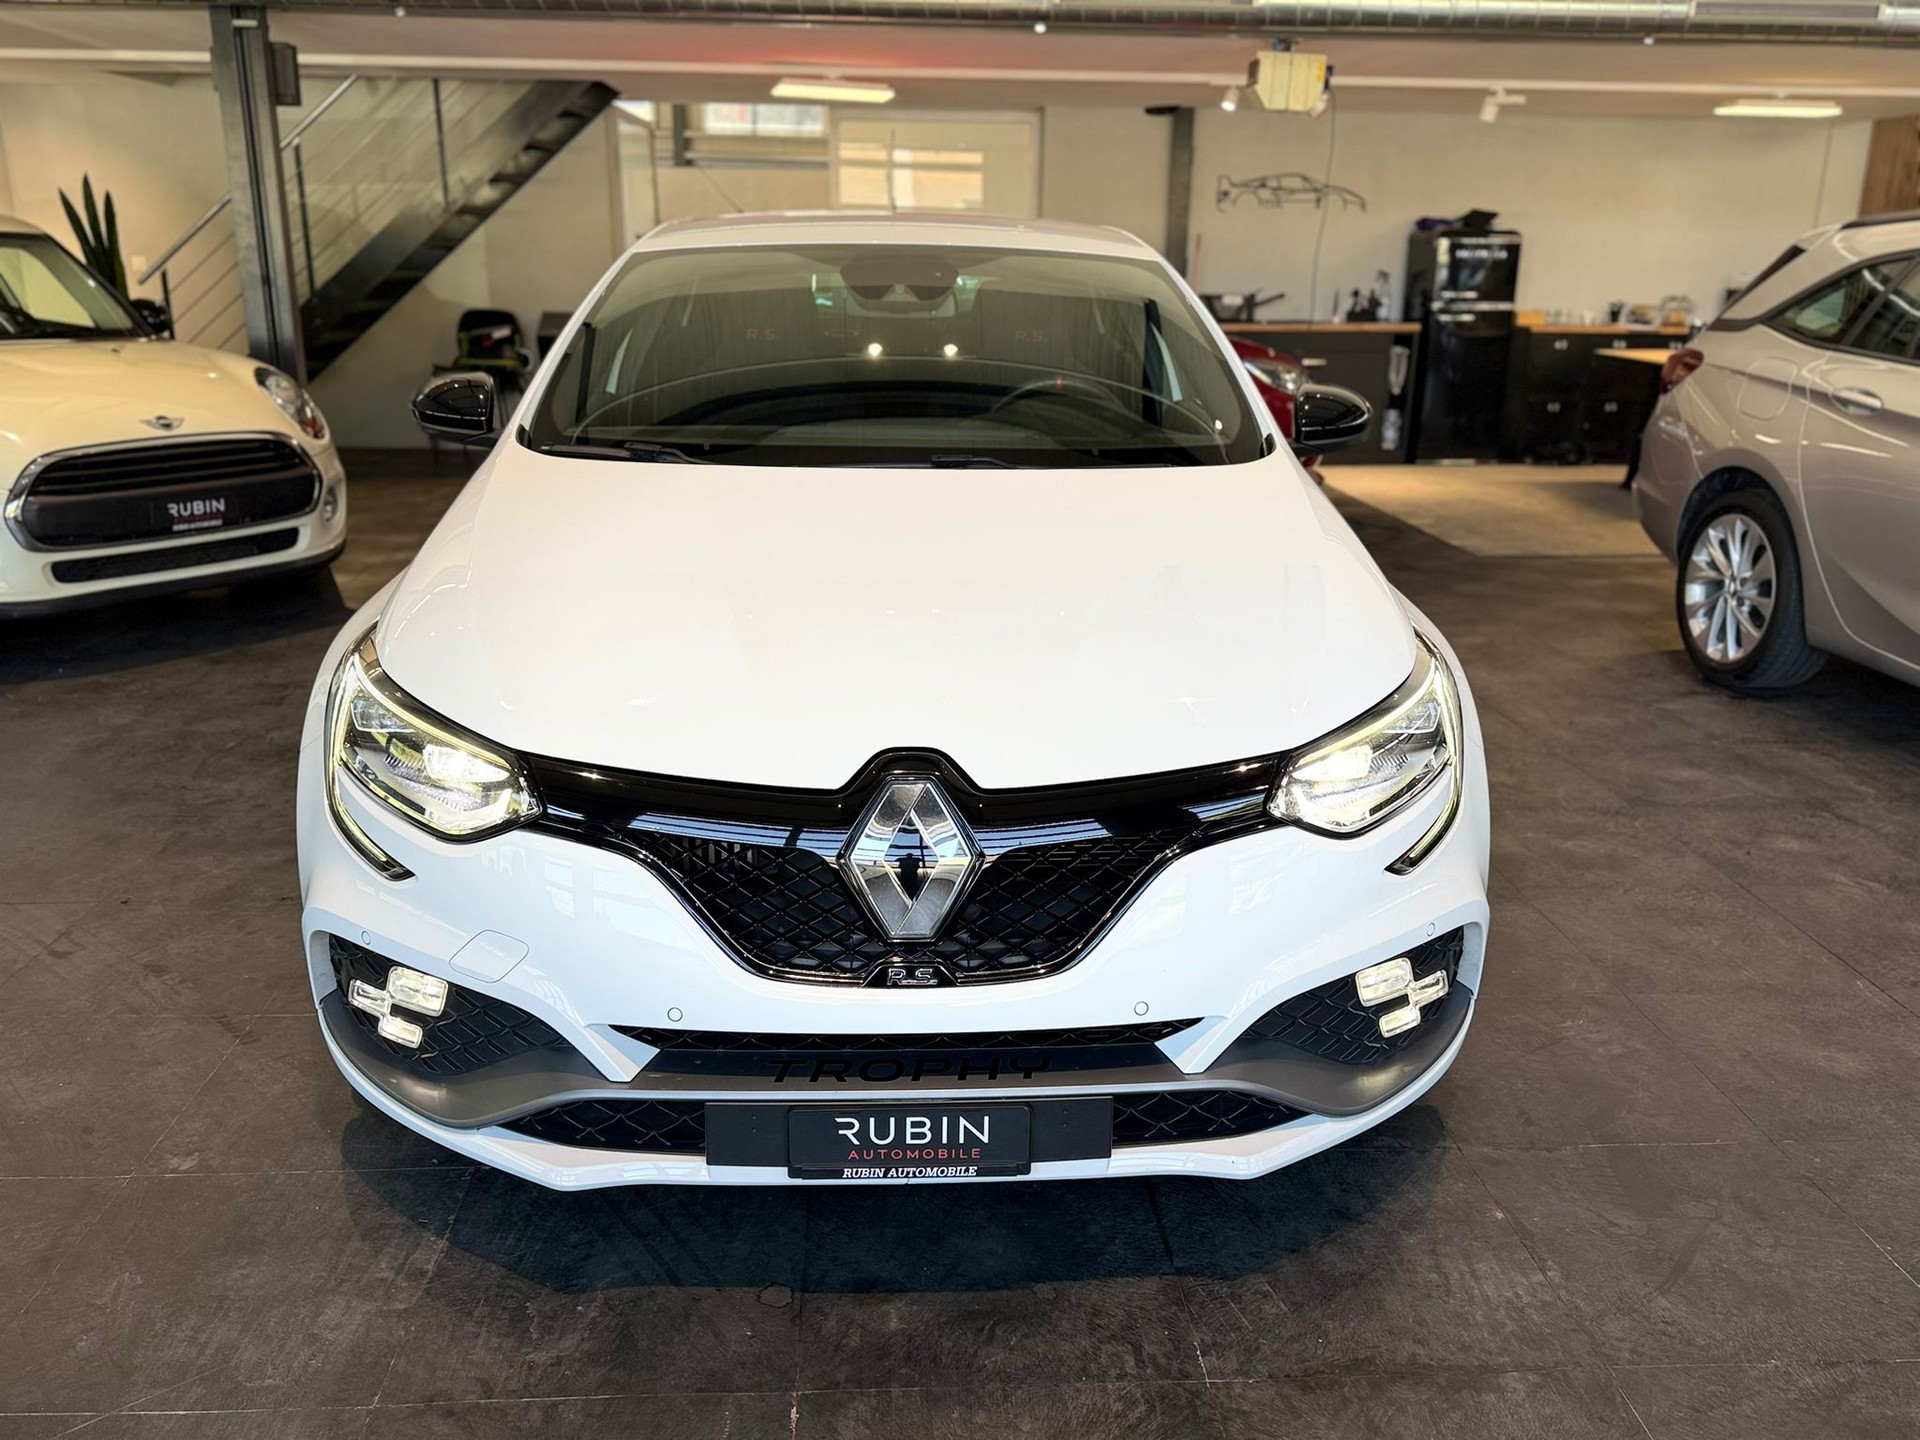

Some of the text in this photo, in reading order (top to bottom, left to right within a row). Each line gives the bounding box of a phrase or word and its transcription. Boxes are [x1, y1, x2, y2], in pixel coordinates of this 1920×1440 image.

[167, 498, 225, 517] RUBIN
[767, 1056, 1050, 1083] TROPHY
[834, 1115, 989, 1145] RUBIN
[848, 1148, 981, 1160] AUTOMOBILE
[842, 1166, 977, 1178] RUBIN AUTOMOBILE
